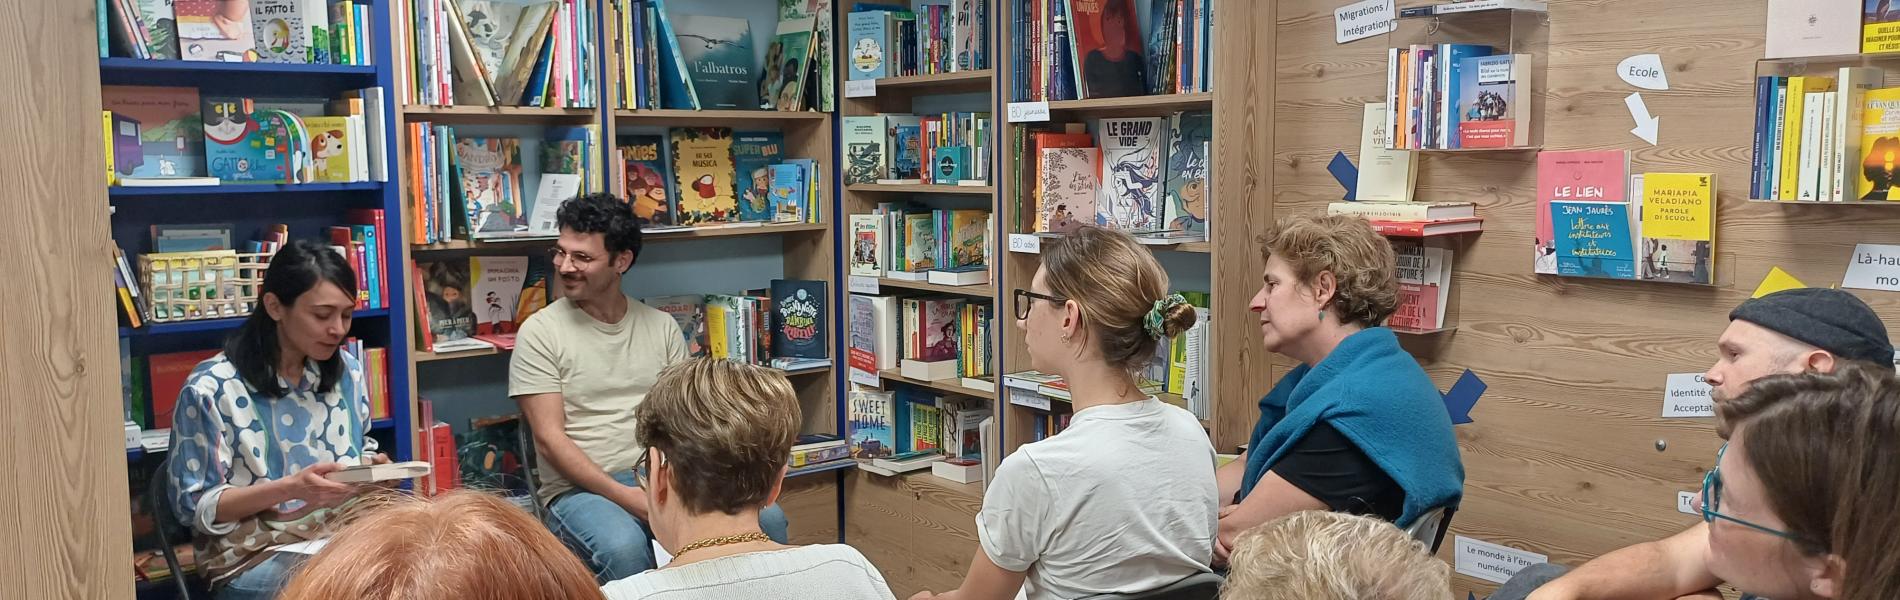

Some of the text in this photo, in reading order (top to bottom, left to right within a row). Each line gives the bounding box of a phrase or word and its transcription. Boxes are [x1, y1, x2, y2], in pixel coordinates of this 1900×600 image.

[255, 7, 263, 15] IL
[265, 4, 288, 15] FATTO
[1339, 4, 1384, 21] Migrations
[1343, 20, 1389, 37] Intégration
[694, 61, 748, 75] l'albatros
[1629, 66, 1659, 79] Ecole
[1106, 121, 1152, 137] LE GRAND
[1119, 137, 1138, 147] VIDE
[1554, 186, 1604, 198] LE LIEN
[1653, 189, 1698, 197] MARIAPIA
[1649, 197, 1702, 205] VELADIANO
[1562, 204, 1614, 216] JEAN JAURÈS
[1660, 207, 1689, 215] PAROLE
[1876, 276, 1899, 286] mo
[1694, 375, 1705, 383] Co
[1670, 387, 1706, 397] Identité
[853, 399, 886, 415] SWEET
[1673, 404, 1713, 414] Acceptat
[854, 414, 886, 431] HOME
[1681, 495, 1692, 506] Té
[1467, 546, 1532, 567] Le monde à l'ère
[1477, 561, 1518, 577] numériqu
